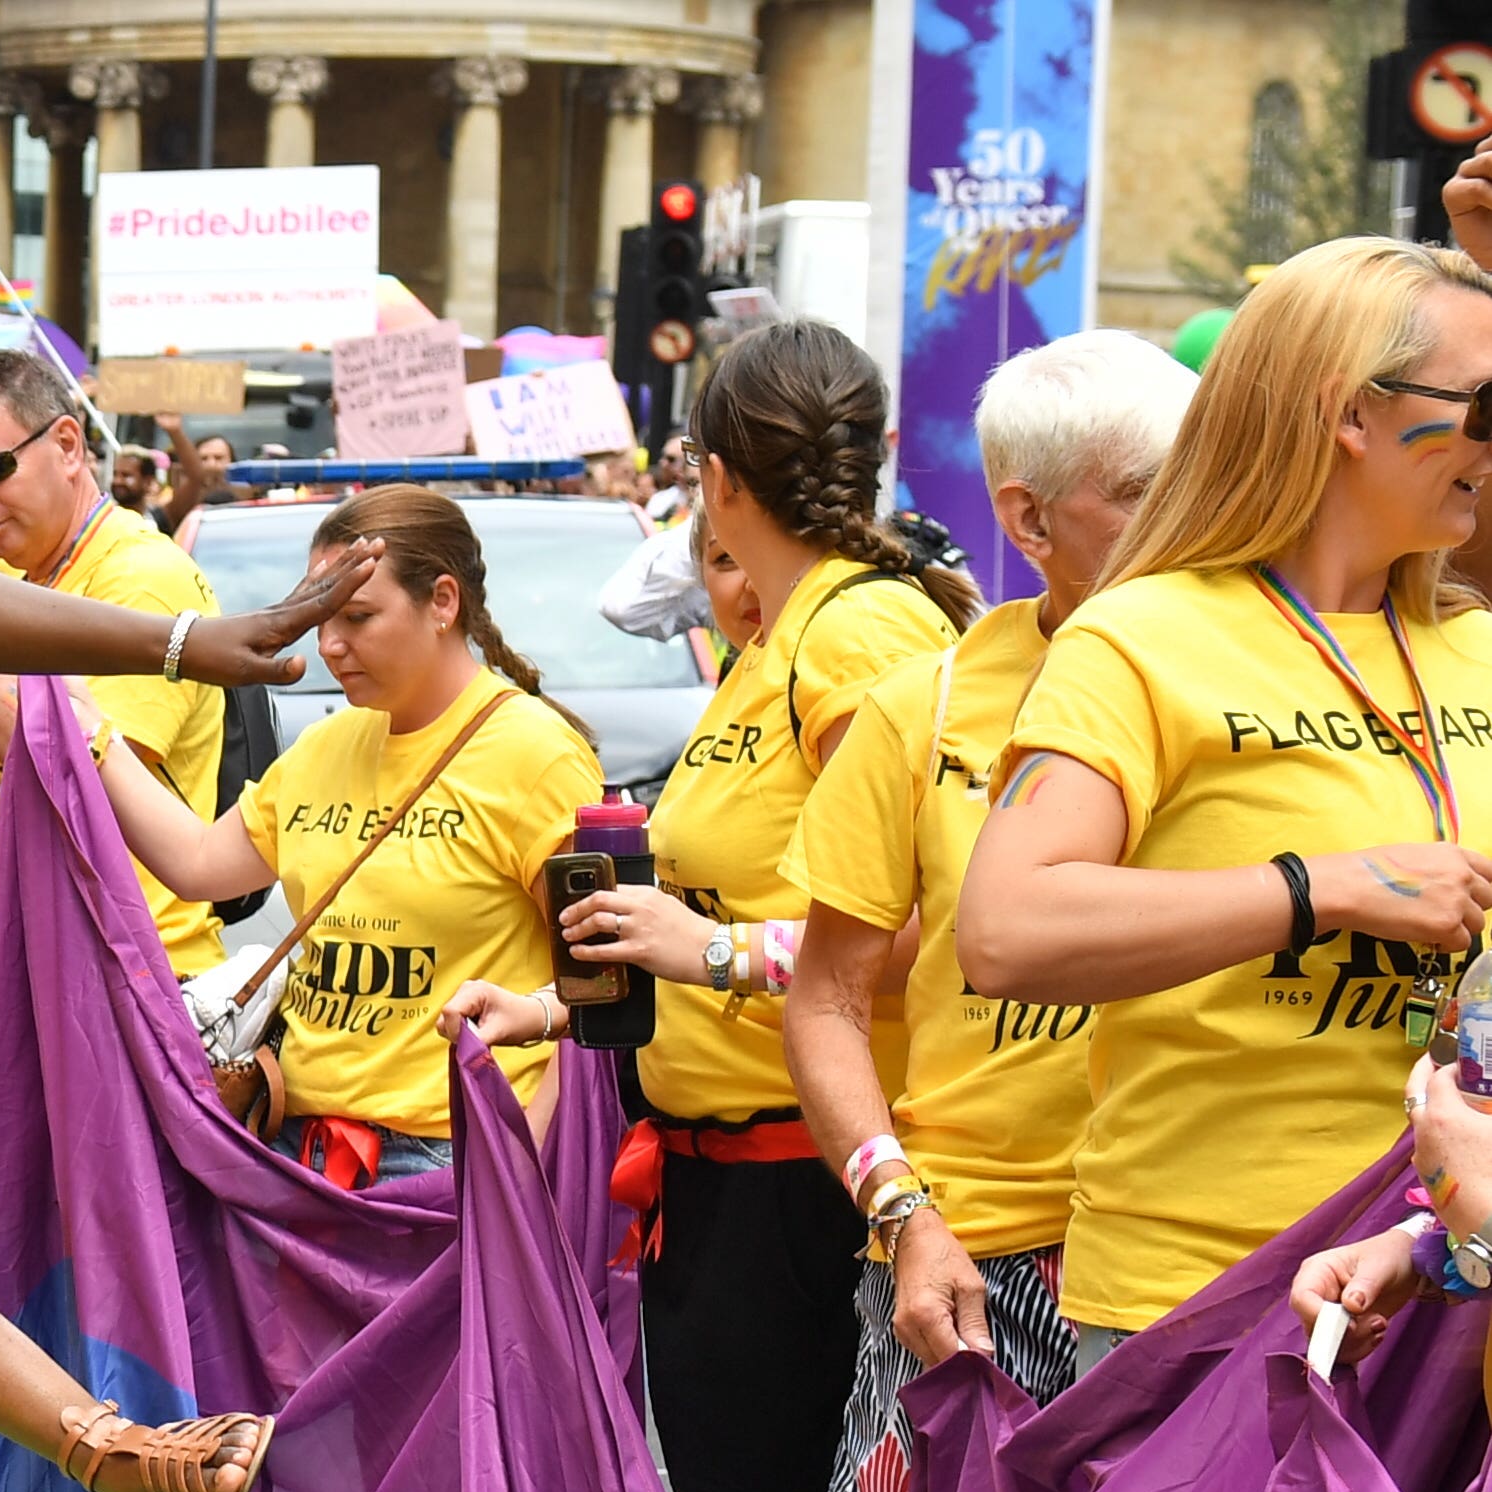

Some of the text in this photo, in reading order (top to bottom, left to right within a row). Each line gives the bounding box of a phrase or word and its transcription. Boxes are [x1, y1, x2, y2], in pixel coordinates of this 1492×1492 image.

[968, 127, 1046, 179] 50
[929, 166, 1046, 206] Years
[108, 204, 370, 238] #PrideJubilee
[1223, 710, 1364, 752] FLAG
[350, 913, 367, 929] to
[371, 917, 401, 932] our
[1264, 989, 1313, 1006] 1969
[400, 1006, 430, 1021] 2019
[963, 1006, 991, 1022] 1969
